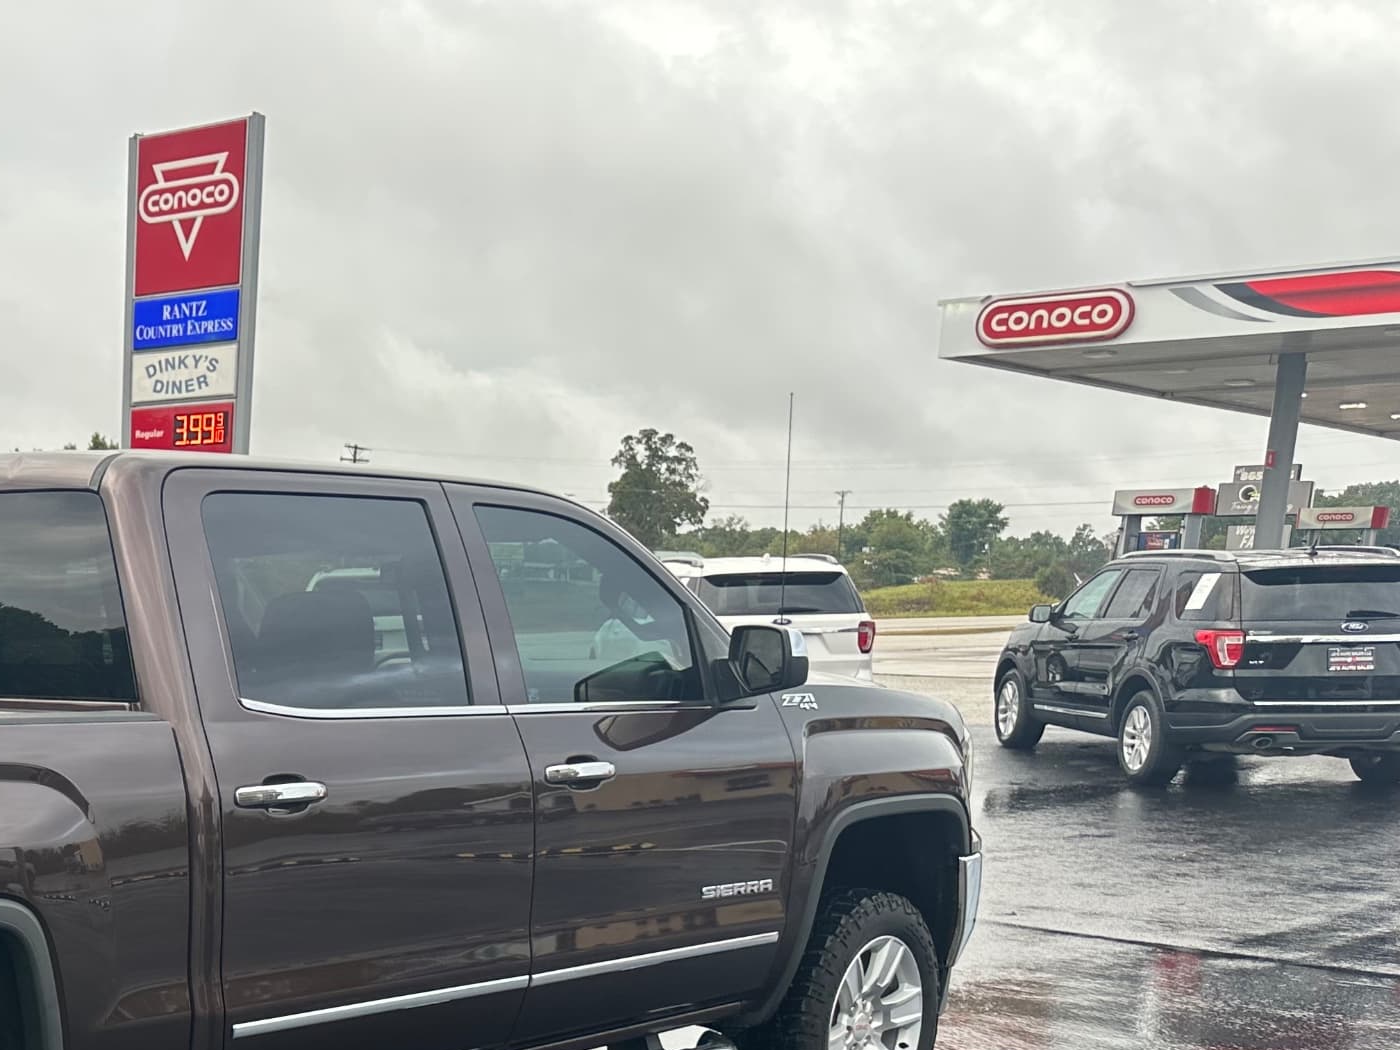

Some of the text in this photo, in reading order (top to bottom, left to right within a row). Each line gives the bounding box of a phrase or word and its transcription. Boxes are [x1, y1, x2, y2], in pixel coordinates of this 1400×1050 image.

[162, 300, 207, 321] RANTZ
[135, 318, 233, 341] COUNTRY EXPRESS
[144, 354, 220, 379] DINKY'S
[152, 374, 210, 395] DINER
[135, 427, 164, 440] Regular
[174, 413, 215, 446] 3.99
[702, 879, 773, 899] SIERRA
